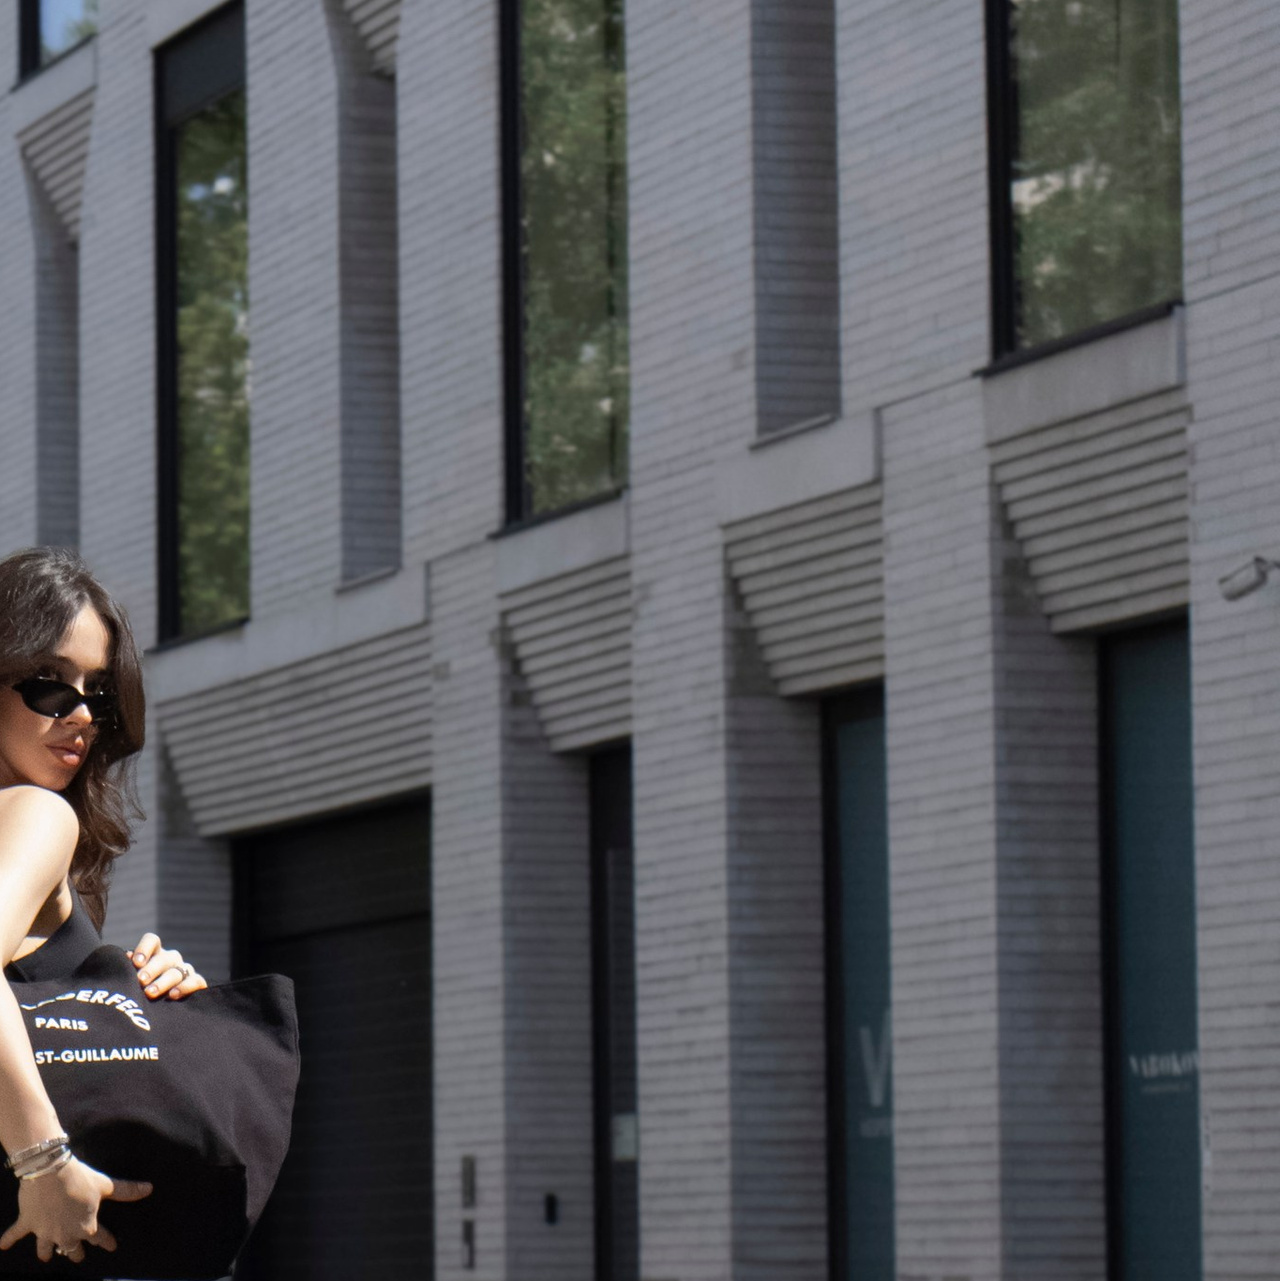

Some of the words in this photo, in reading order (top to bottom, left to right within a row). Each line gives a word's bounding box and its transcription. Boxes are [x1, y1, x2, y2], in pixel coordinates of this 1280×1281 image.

[21, 989, 151, 1032] ERFELD
[35, 1017, 89, 1032] PARIS
[35, 1047, 159, 1065] ST-GUILLAUME
